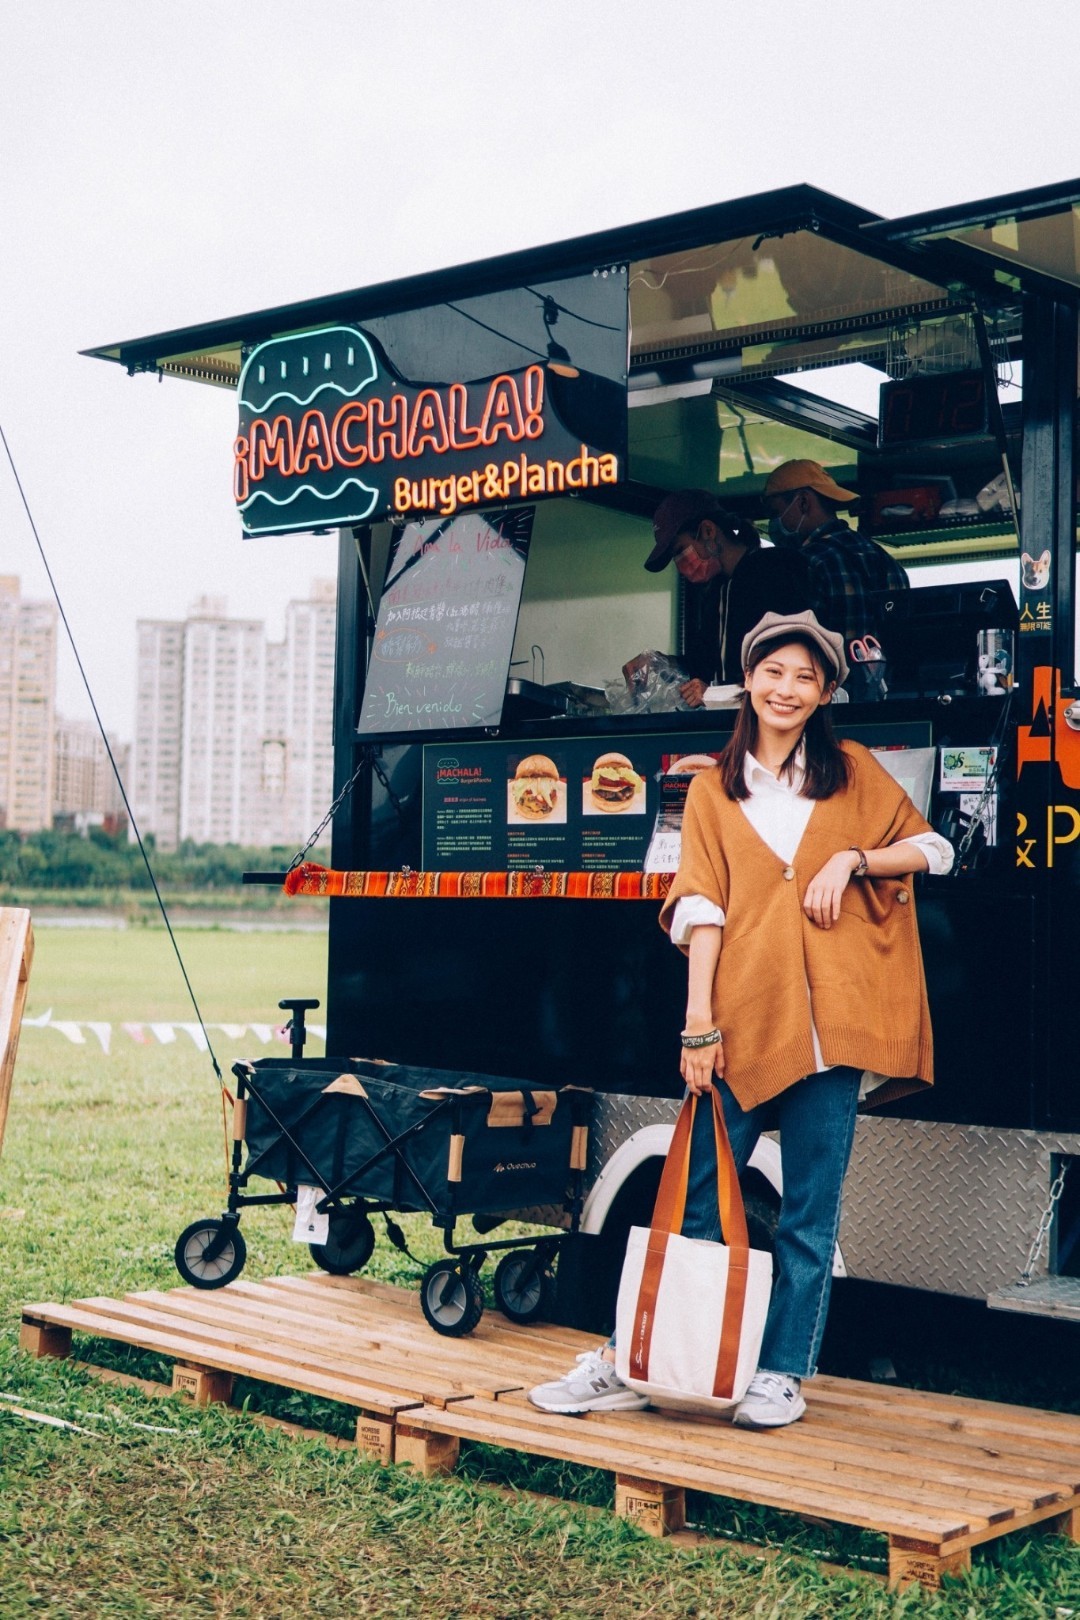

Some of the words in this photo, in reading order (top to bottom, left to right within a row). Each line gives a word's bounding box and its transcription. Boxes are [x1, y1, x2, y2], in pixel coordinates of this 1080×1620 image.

[233, 364, 545, 502] ¡MACHALA!
[394, 443, 620, 517] Burger&Plancha
[1019, 601, 1053, 621] 人生
[589, 1376, 610, 1393] N
